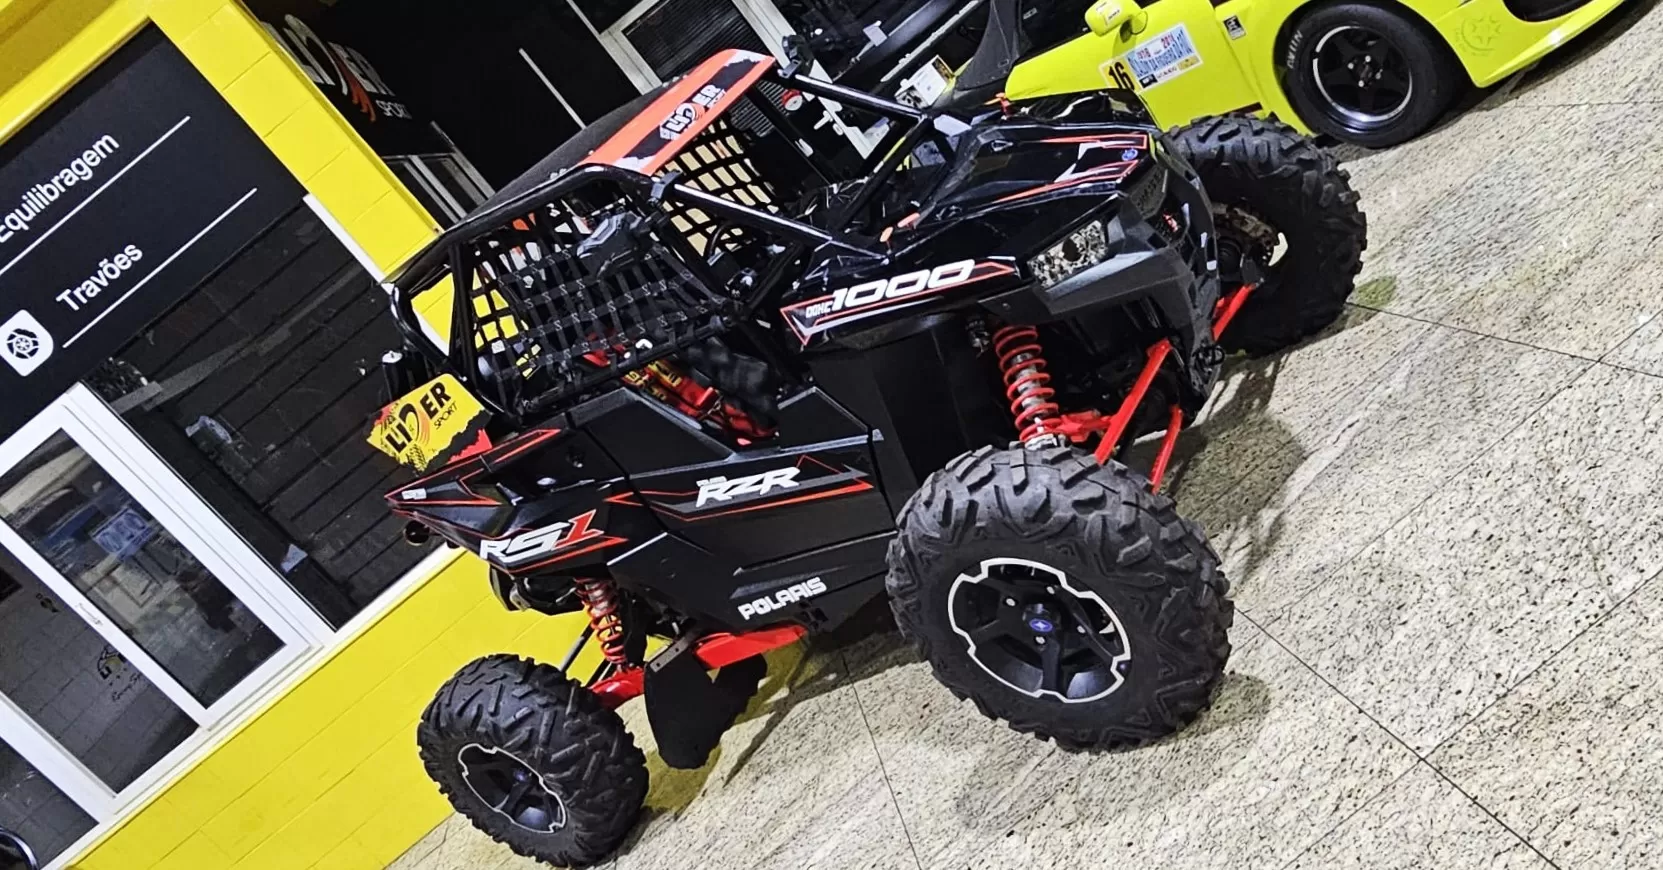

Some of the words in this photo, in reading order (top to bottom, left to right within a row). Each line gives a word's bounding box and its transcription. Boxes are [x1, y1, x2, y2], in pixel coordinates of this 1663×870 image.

[1108, 61, 1135, 90] 16
[55, 244, 143, 311] Travões
[831, 259, 976, 311] 1000
[384, 382, 452, 454] LIDER
[433, 401, 459, 430] SPORT
[695, 466, 801, 507] RZR
[480, 509, 605, 563] RS1
[738, 577, 827, 621] POLARIS
